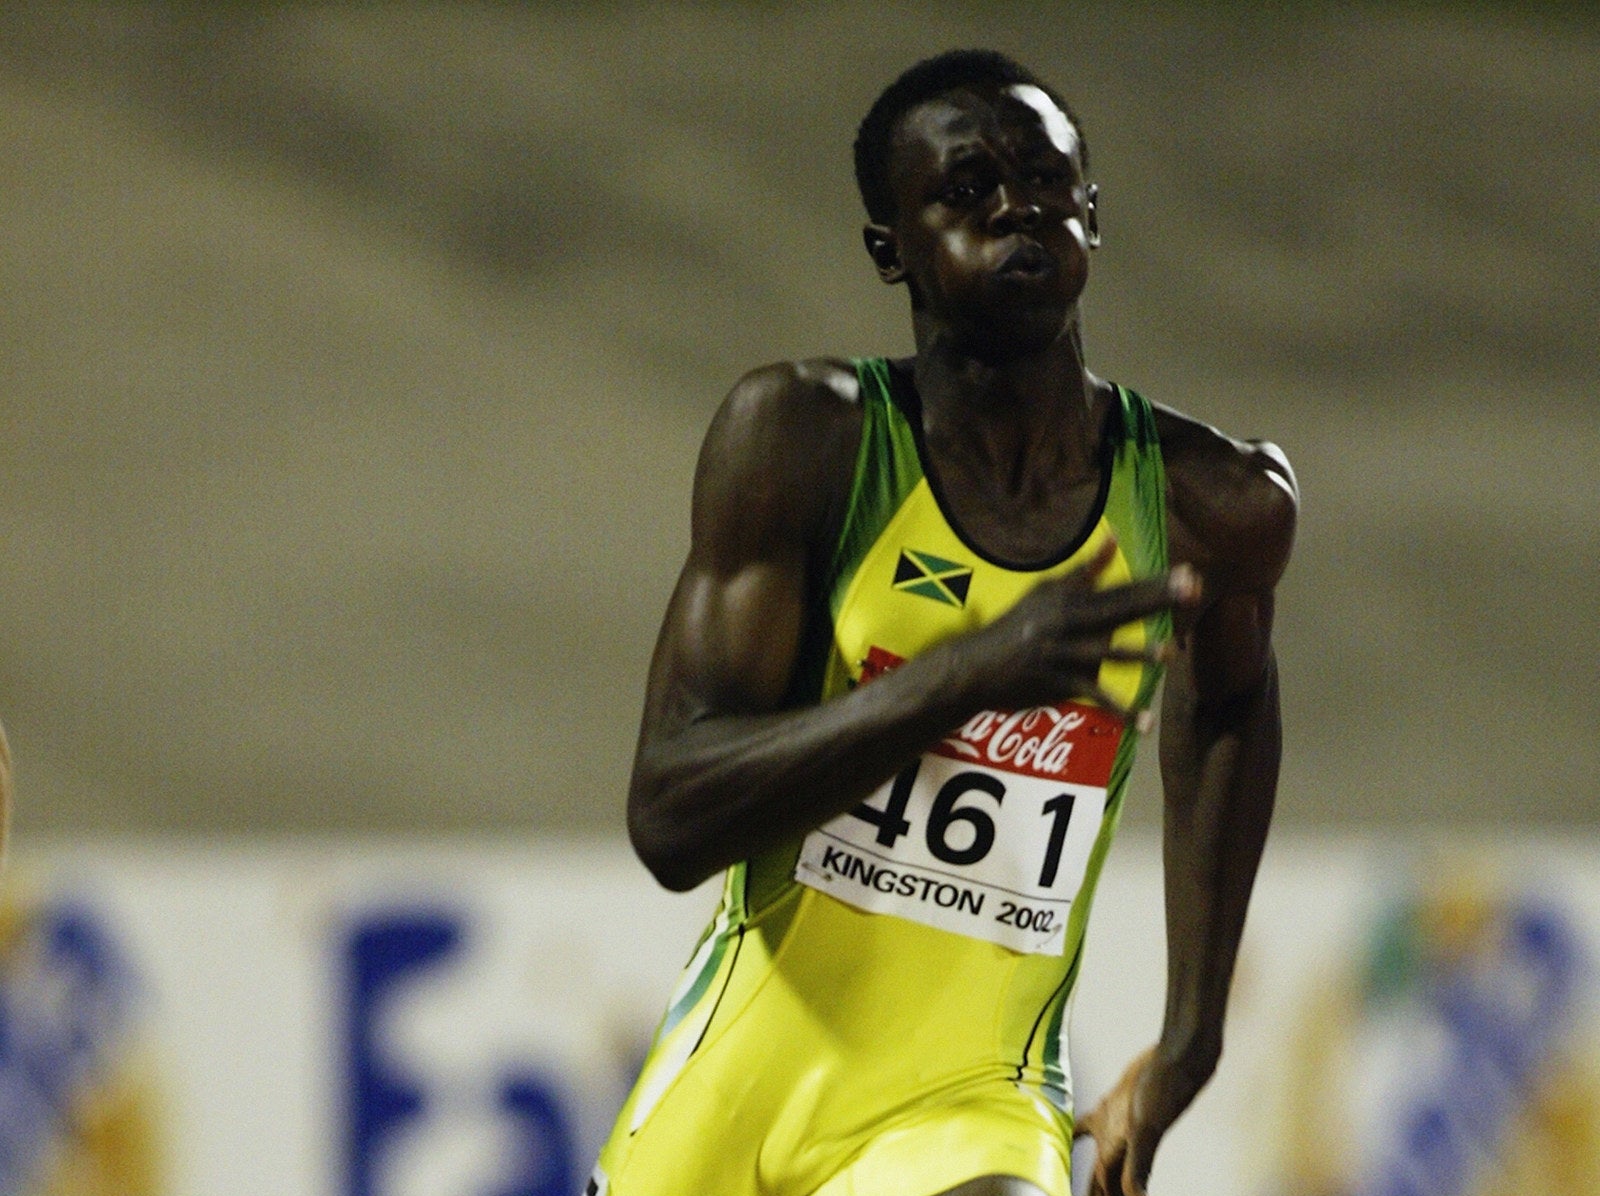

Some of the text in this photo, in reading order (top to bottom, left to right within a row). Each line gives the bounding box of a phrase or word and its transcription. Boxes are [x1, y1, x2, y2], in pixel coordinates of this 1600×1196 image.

[956, 706, 1087, 775] a-Cola
[848, 759, 1077, 889] 461
[821, 845, 1055, 933] KINGSTON 2002
